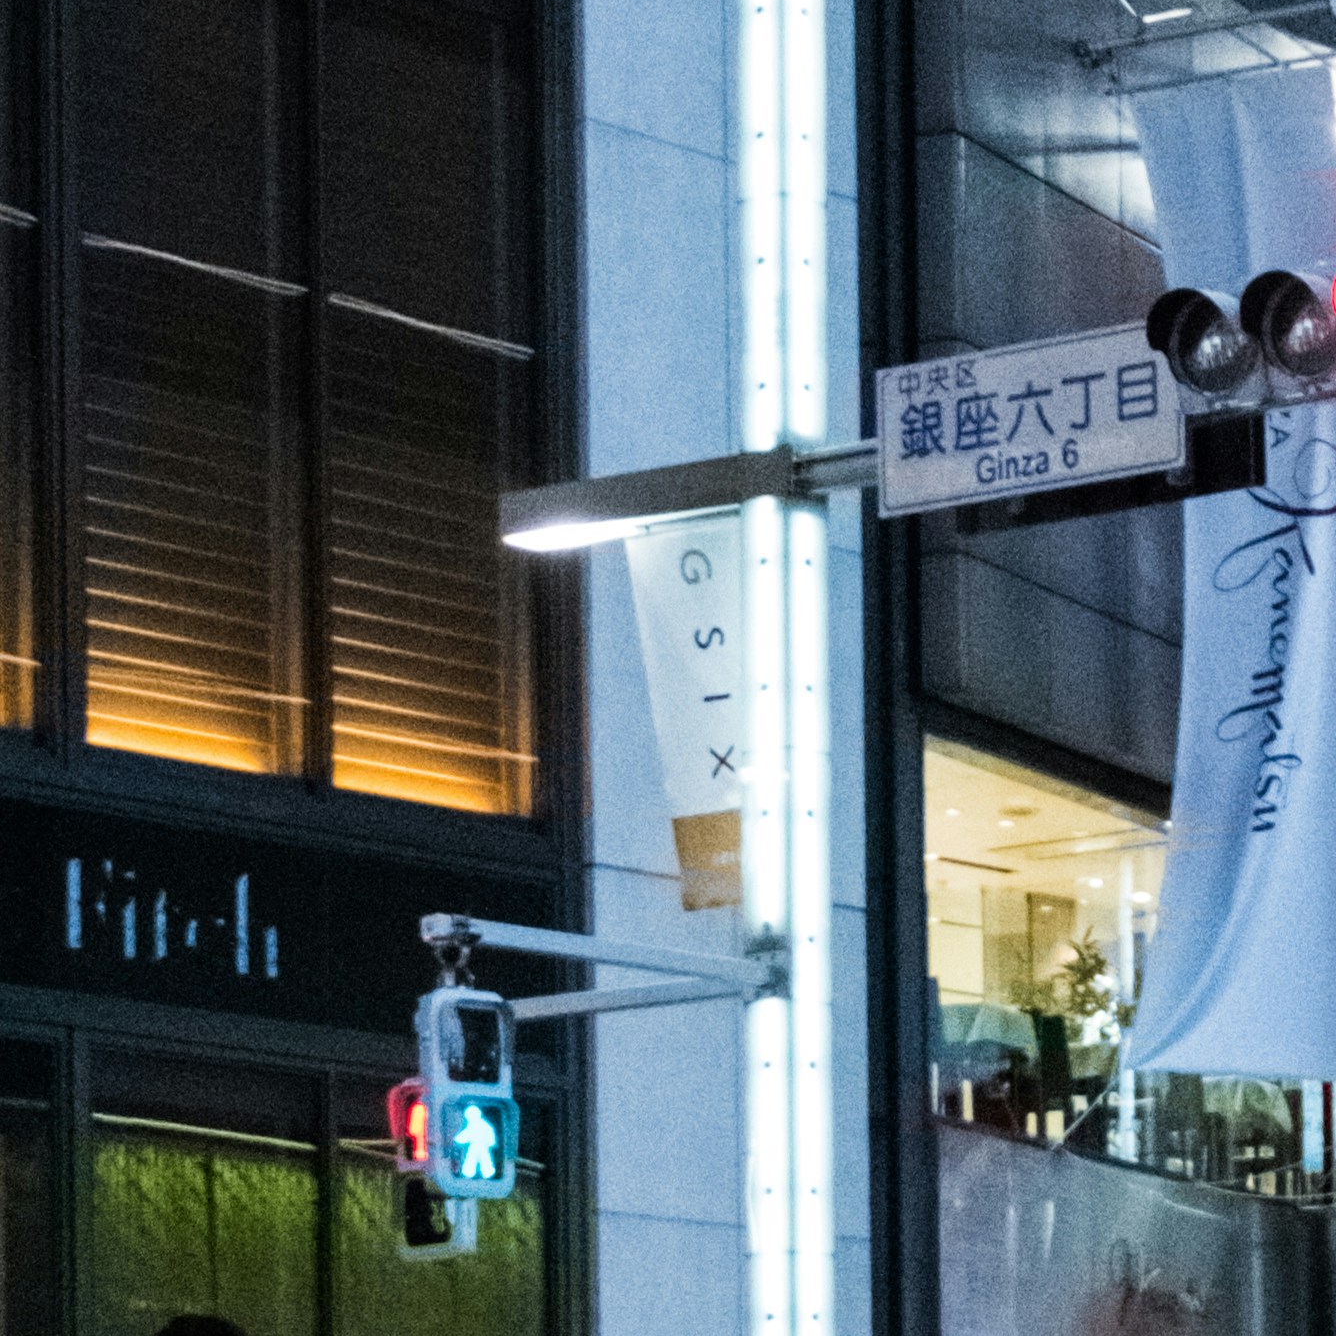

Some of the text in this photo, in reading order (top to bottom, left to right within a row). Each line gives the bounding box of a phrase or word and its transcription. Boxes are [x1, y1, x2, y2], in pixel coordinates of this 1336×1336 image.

[899, 359, 978, 399] 中央区
[900, 360, 1158, 460] 銀座六丁目
[975, 438, 1080, 484] Ginza 6
